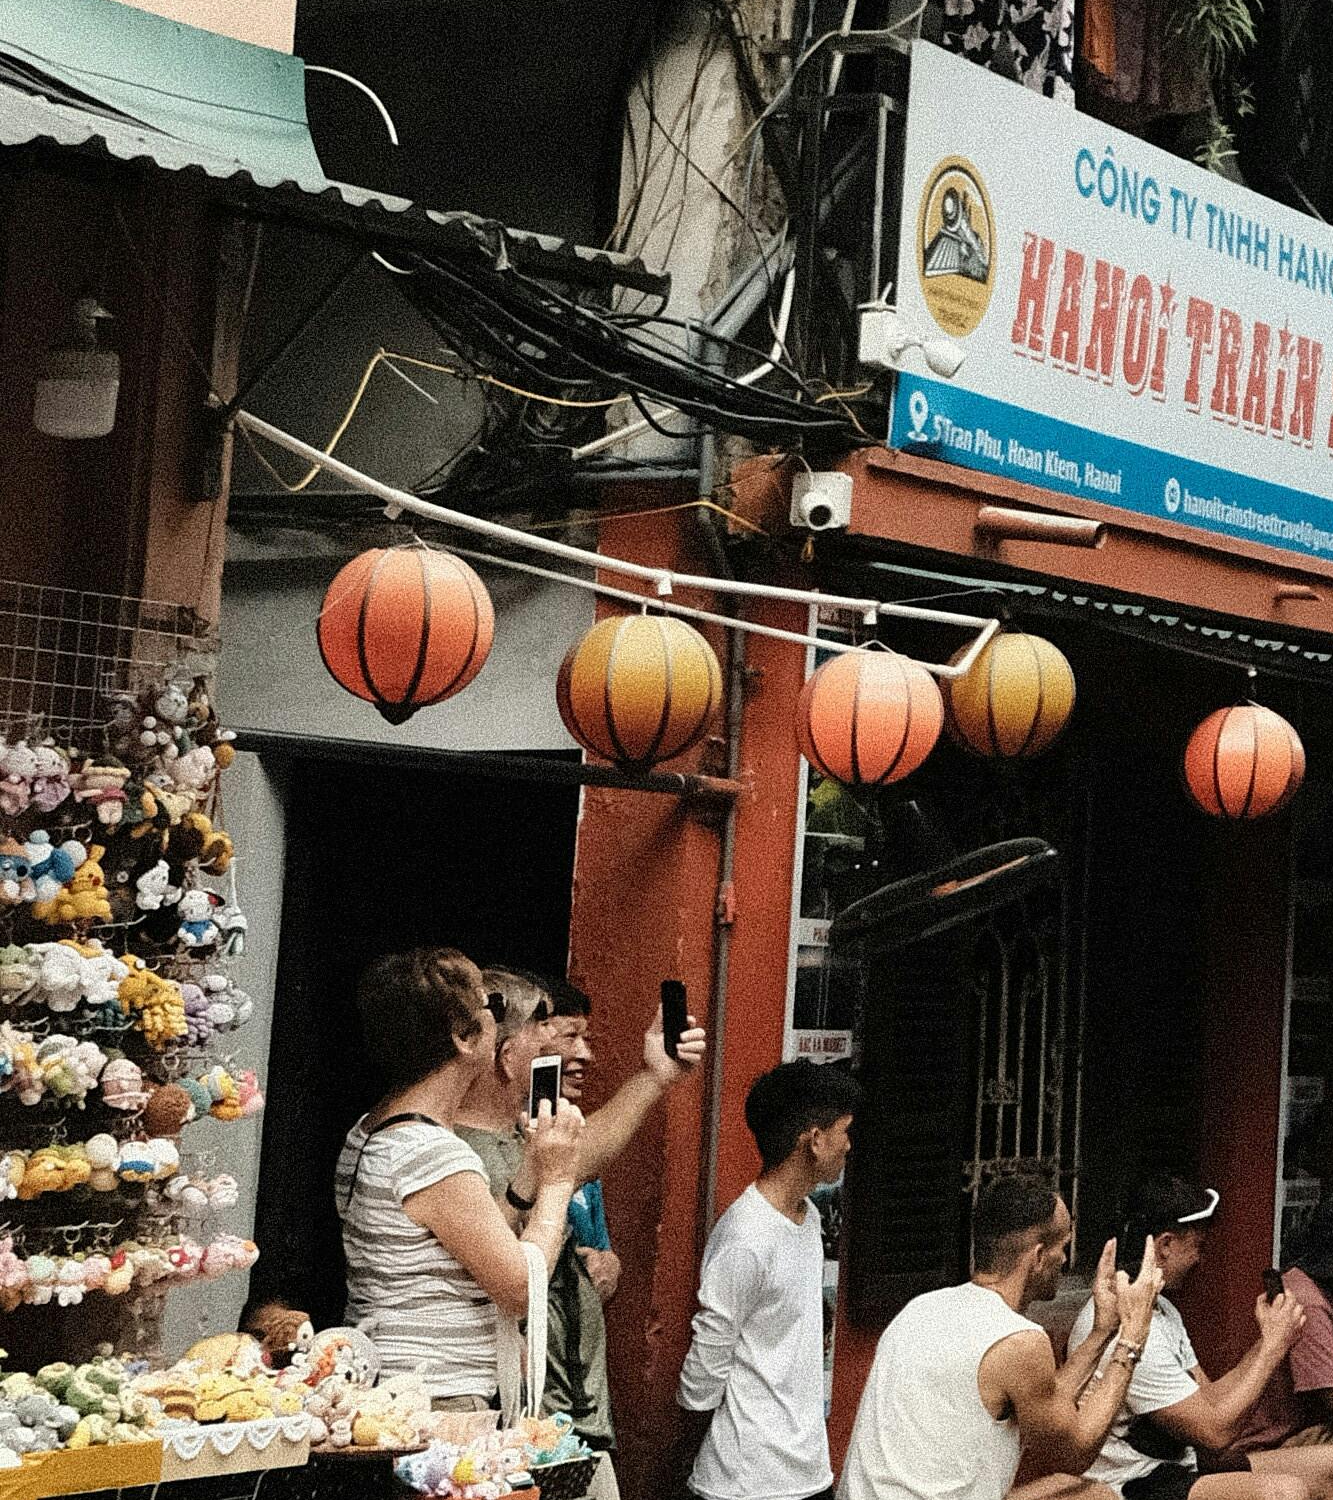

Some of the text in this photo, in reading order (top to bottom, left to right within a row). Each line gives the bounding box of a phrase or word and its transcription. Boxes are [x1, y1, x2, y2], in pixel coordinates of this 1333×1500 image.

[1075, 145, 1161, 225] CÔNG
[1169, 186, 1198, 240] TY
[1206, 203, 1269, 271] TNHH
[1008, 438, 1043, 473] Hoan
[1084, 462, 1122, 494] Hanoi
